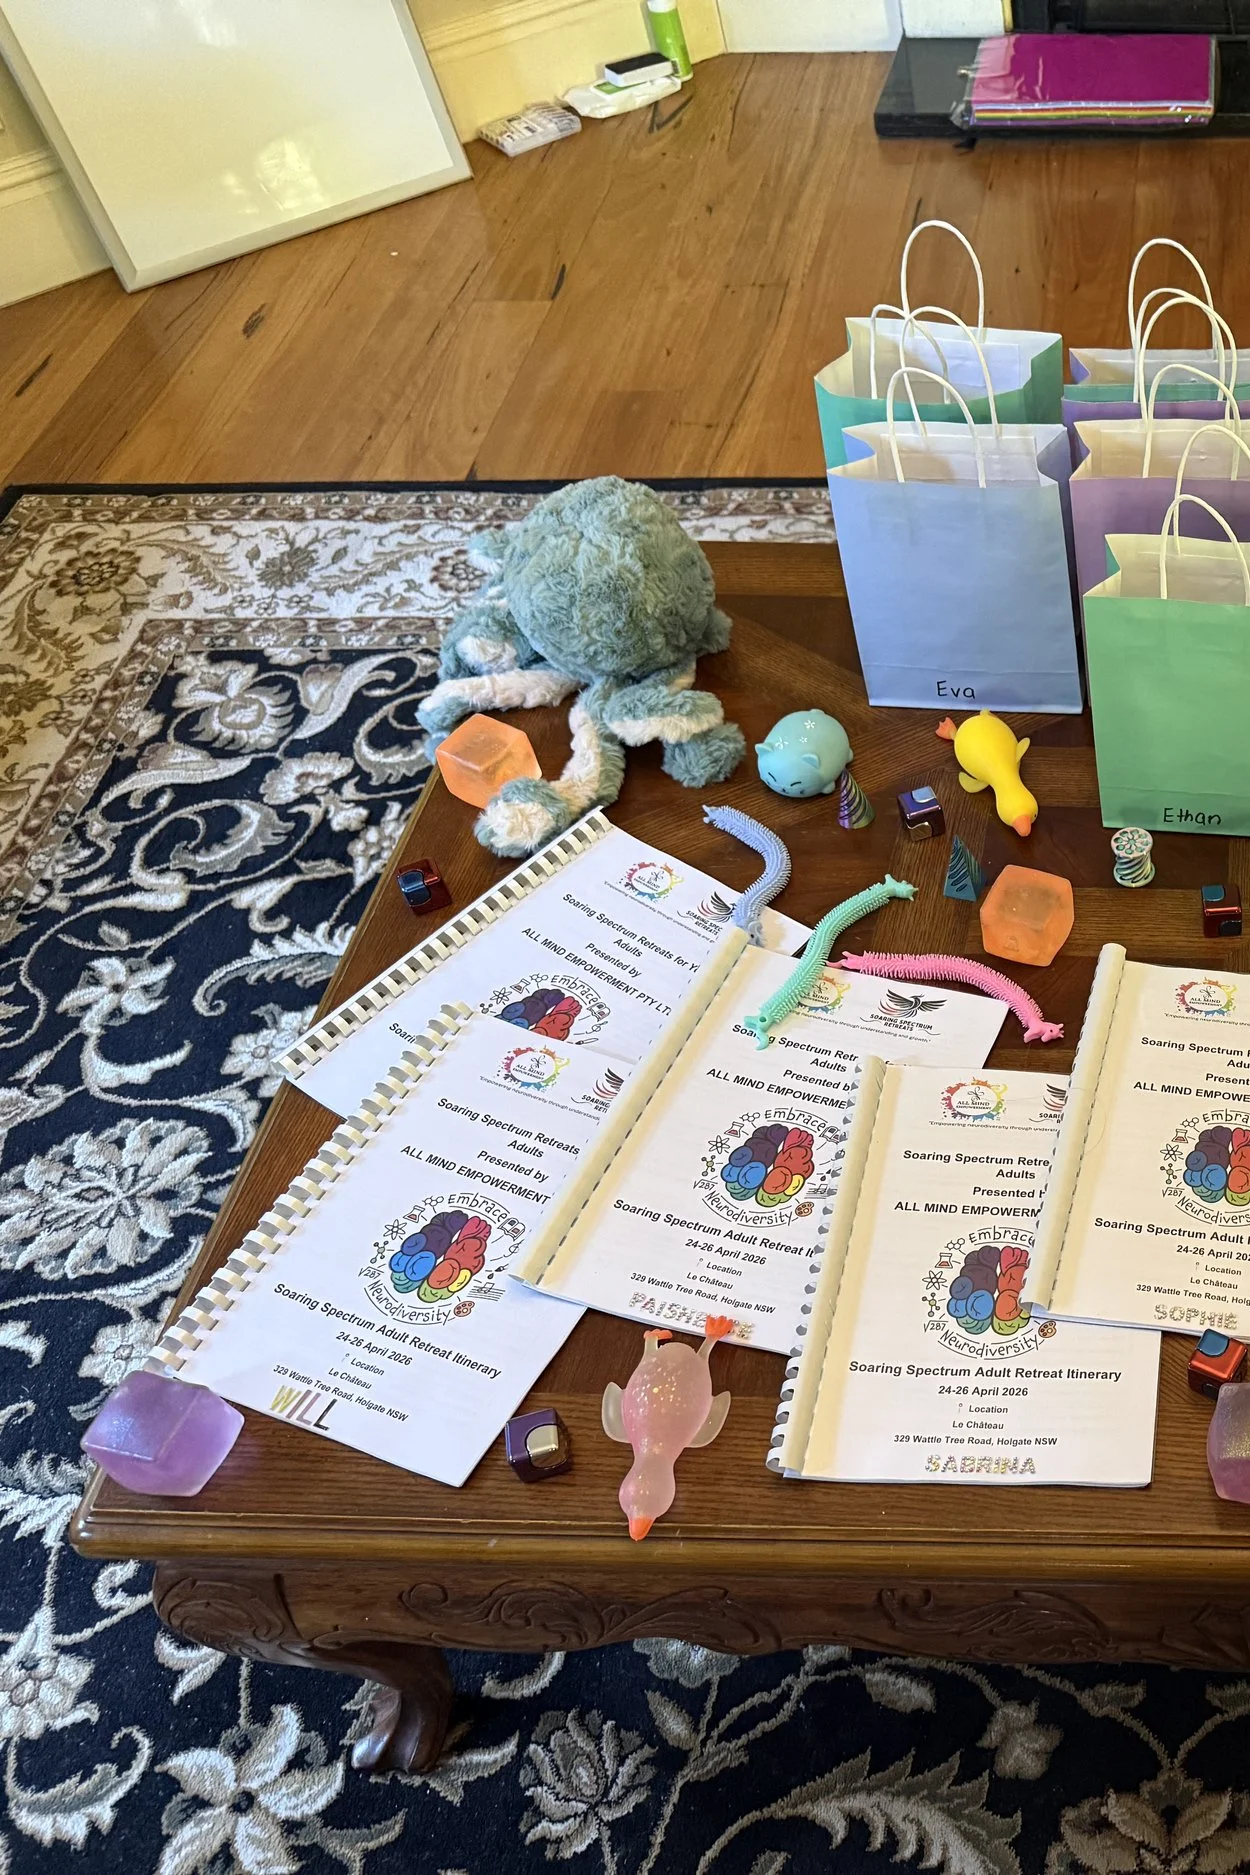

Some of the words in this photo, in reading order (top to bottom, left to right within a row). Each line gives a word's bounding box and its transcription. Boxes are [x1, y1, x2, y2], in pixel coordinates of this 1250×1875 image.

[937, 680, 976, 700] Eva
[1164, 808, 1222, 826] Ethan
[563, 894, 596, 917] Soaring
[596, 914, 637, 941] Spectrum
[638, 936, 674, 960] Retreats
[674, 956, 688, 967] for
[585, 943, 630, 970] Presented
[628, 967, 642, 978] by
[613, 939, 642, 957] Adults
[522, 928, 540, 942] ALL
[541, 939, 566, 955] MIND
[565, 953, 638, 995] EMPOWERMENT
[636, 993, 656, 1009] PTY
[551, 976, 599, 1004] Embrace
[870, 1014, 899, 1024] SOARING
[900, 1019, 933, 1030] SPECTRUM
[884, 1022, 913, 1032] RETREATS
[1141, 1037, 1185, 1051] Soaring
[1189, 1043, 1243, 1057] Spectrum
[438, 1098, 480, 1121] Soaring
[481, 1114, 533, 1138] Spectrum
[534, 1133, 580, 1159] Retreats
[765, 1107, 826, 1131] Embrace
[401, 1146, 423, 1160] ALL
[425, 1154, 456, 1170] MIND
[457, 1166, 551, 1204] EMPOWERMENT
[477, 1151, 534, 1176] Presented
[533, 1170, 549, 1183] by
[448, 1194, 508, 1222] Embrace
[705, 1190, 794, 1226] Neurodiversity
[614, 1200, 661, 1222] Soaring
[664, 1214, 721, 1236] Spectrum
[723, 1230, 758, 1245] Adult
[759, 1238, 804, 1255] Retreat
[1095, 1218, 1142, 1233] Soaring
[1147, 1224, 1206, 1239] Spectrum
[1210, 1232, 1244, 1244] Adult
[1177, 1245, 1204, 1255] 24-26
[1208, 1249, 1233, 1259] April
[368, 1279, 450, 1325] Neurodiversity
[1154, 1304, 1238, 1330] SOPHIE
[274, 1284, 320, 1310] Soaring
[321, 1303, 375, 1330] Spectrum
[376, 1325, 409, 1343] Adult
[409, 1336, 452, 1359] Retreat
[452, 1353, 501, 1379] Itinerary
[940, 1329, 1039, 1356] Neurodiversity
[336, 1332, 364, 1347] 24-26
[363, 1342, 389, 1356] April
[387, 1351, 412, 1365] 2026
[328, 1368, 339, 1376] Le
[340, 1373, 371, 1389] Château
[351, 1358, 384, 1375] Location
[849, 1361, 902, 1376] Soaring
[906, 1365, 970, 1377] Spectrum
[975, 1367, 1011, 1377] Adult
[1015, 1368, 1063, 1378] Retreat
[1067, 1369, 1121, 1382] Itinerary
[938, 1386, 968, 1394] 24-26
[972, 1387, 999, 1397] April
[1002, 1387, 1028, 1396] 2026
[270, 1384, 336, 1430] WILL
[969, 1405, 1008, 1413] Location
[966, 1421, 1003, 1429] Château
[945, 1436, 964, 1444] Tree
[968, 1437, 993, 1446] Road,
[997, 1438, 1032, 1447] Holgate
[925, 1454, 1036, 1474] SABRINA
